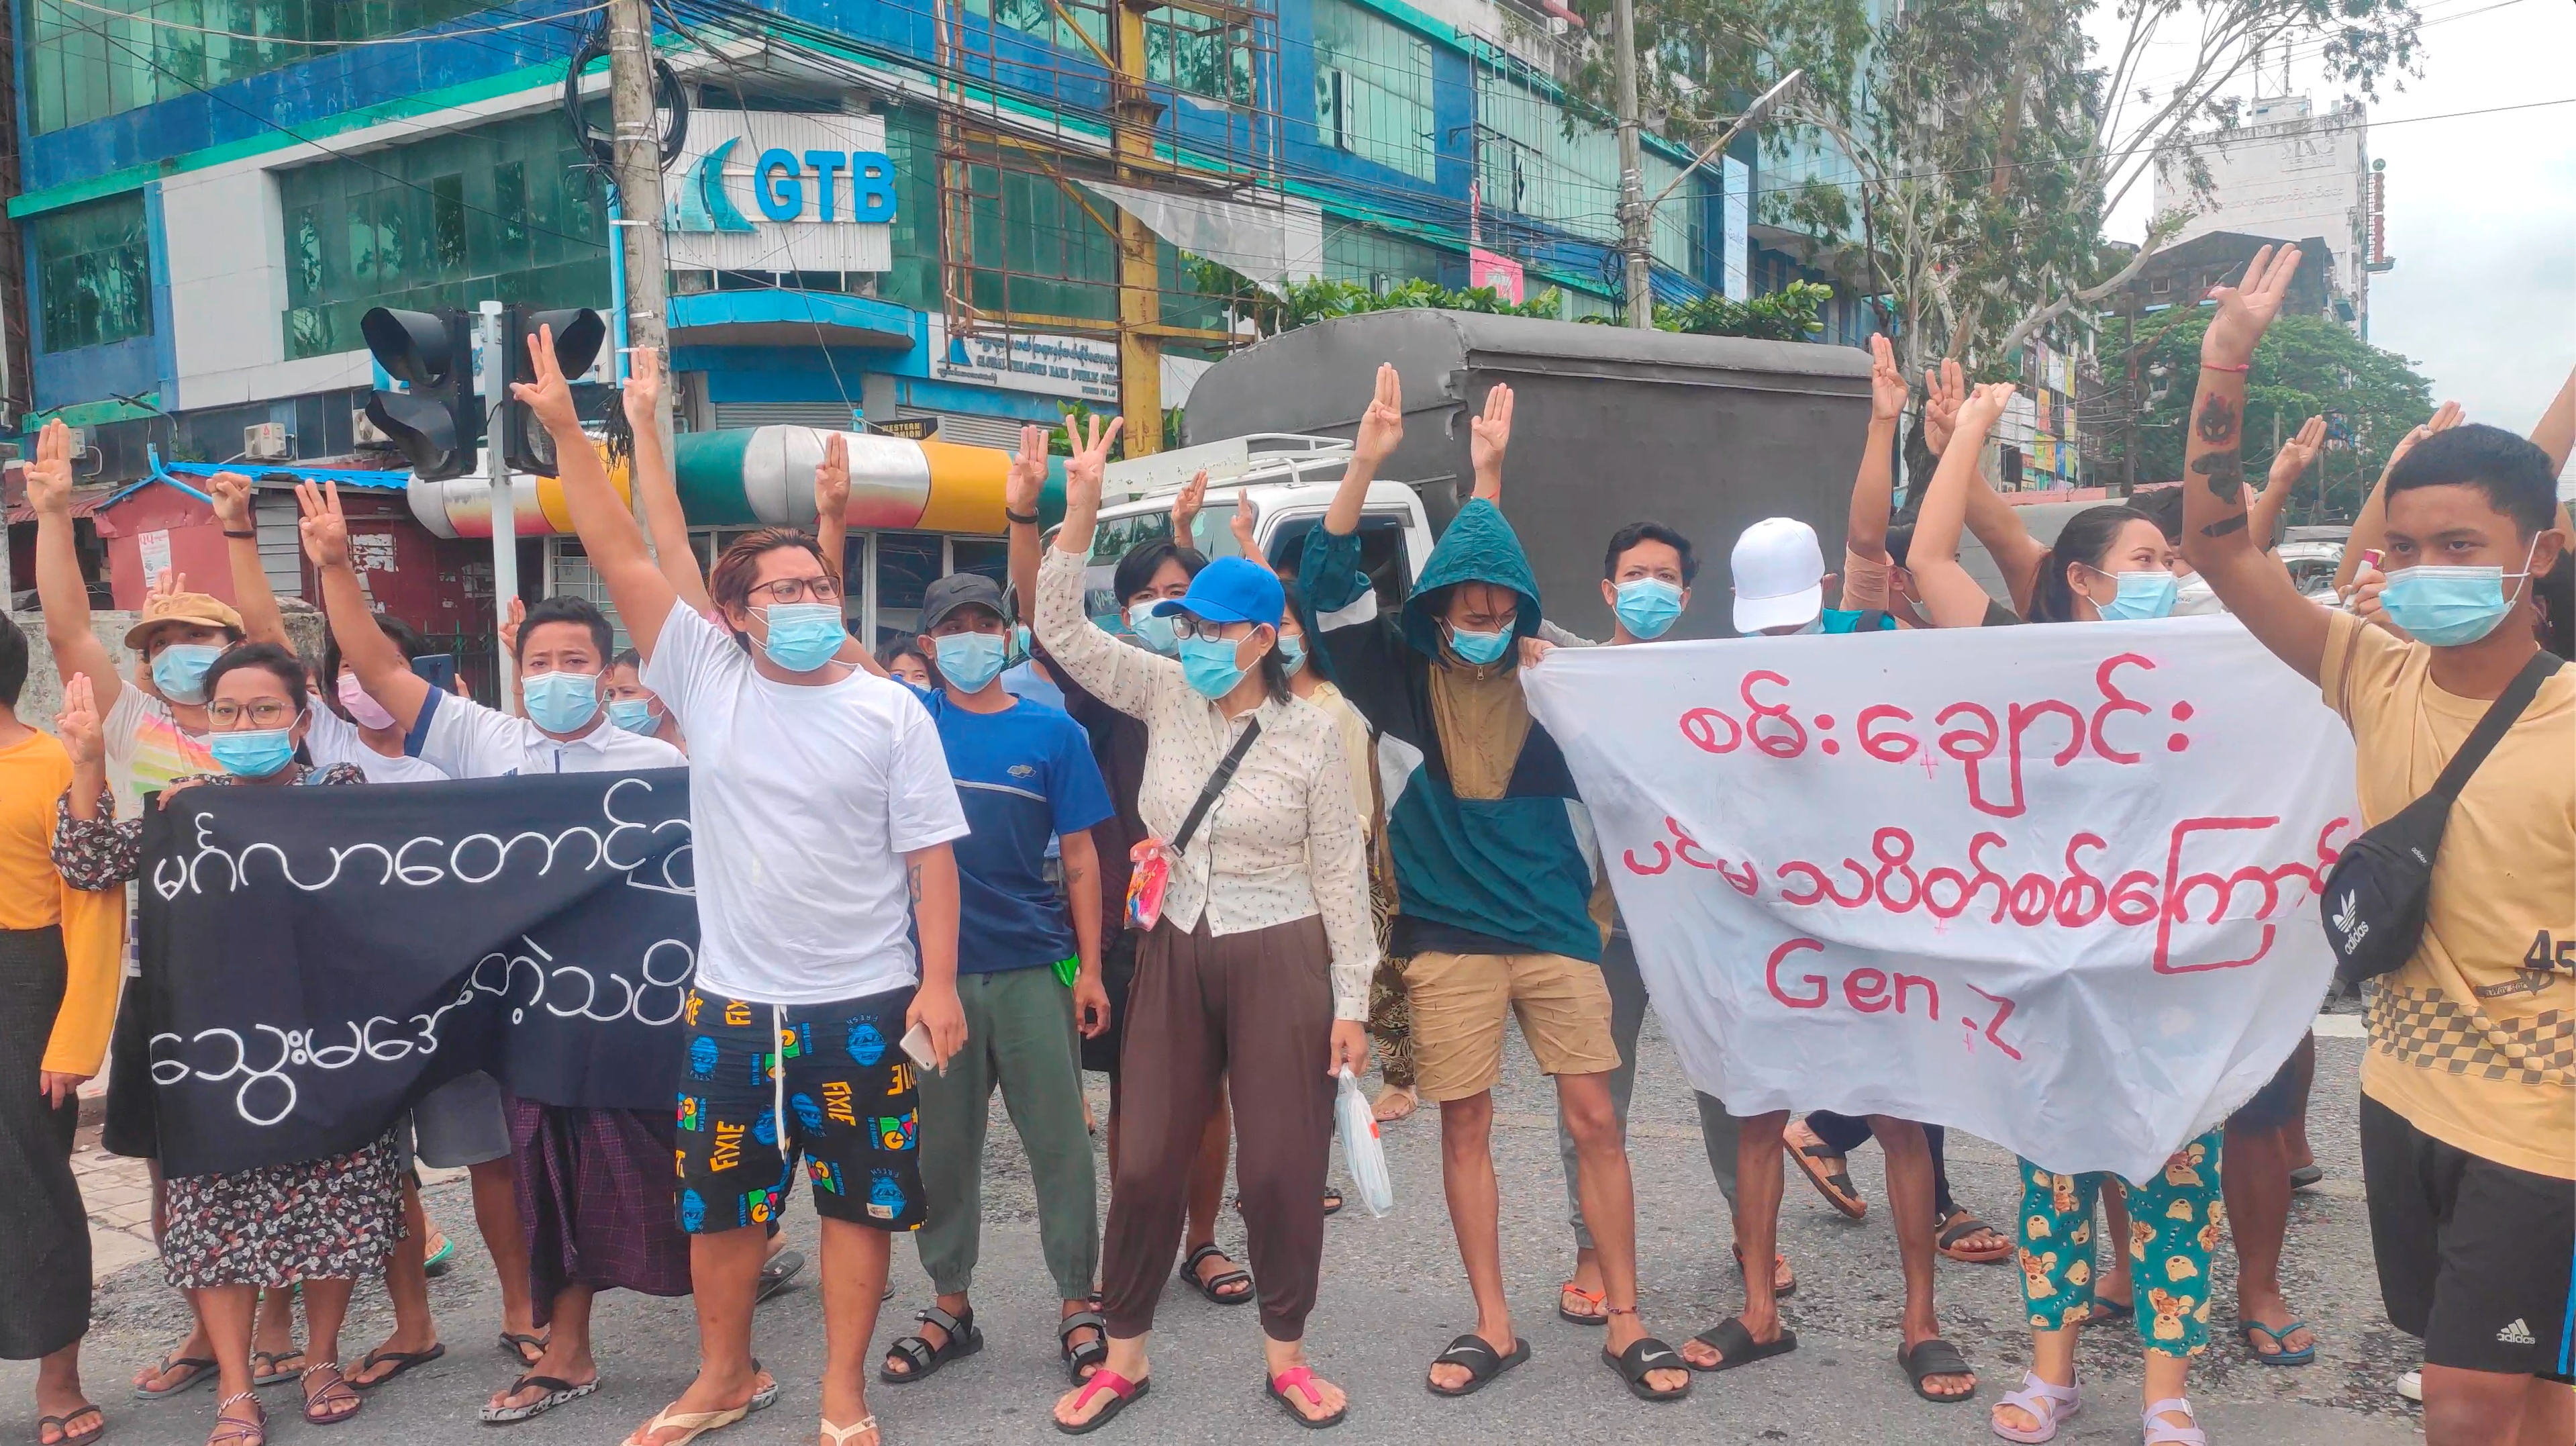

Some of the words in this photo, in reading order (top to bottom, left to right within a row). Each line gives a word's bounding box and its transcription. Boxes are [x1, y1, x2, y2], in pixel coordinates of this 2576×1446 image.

[754, 148, 897, 222] GTB
[881, 422, 920, 432] WESTERN
[2411, 847, 2428, 865] adidas
[2344, 920, 2369, 955] adidas
[822, 1081, 857, 1126] FIXIE
[709, 1120, 745, 1172] FIXIE
[2496, 1333, 2535, 1345] adidas
